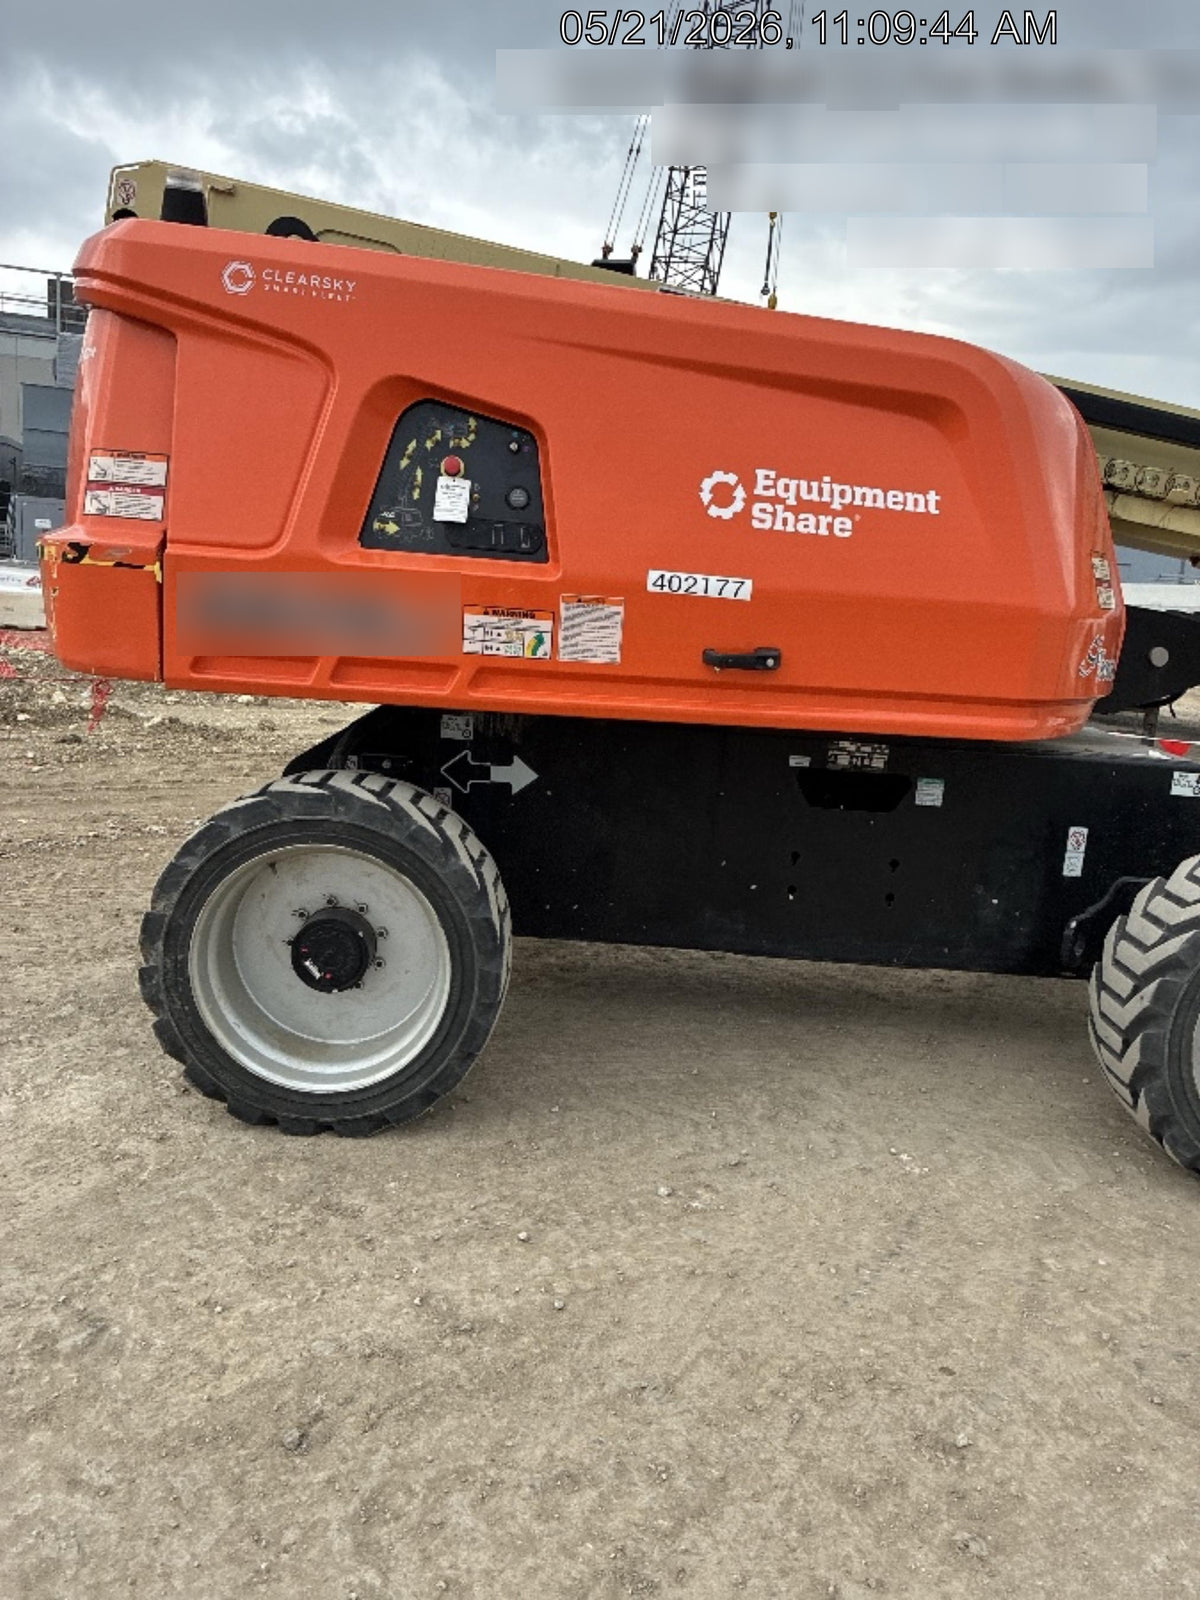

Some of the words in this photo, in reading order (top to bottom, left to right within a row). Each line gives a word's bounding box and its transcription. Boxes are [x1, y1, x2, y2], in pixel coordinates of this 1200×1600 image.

[262, 268, 356, 292] CLEARSKY
[753, 468, 941, 515] Equipment
[751, 502, 853, 538] Share
[651, 573, 746, 599] 402177
